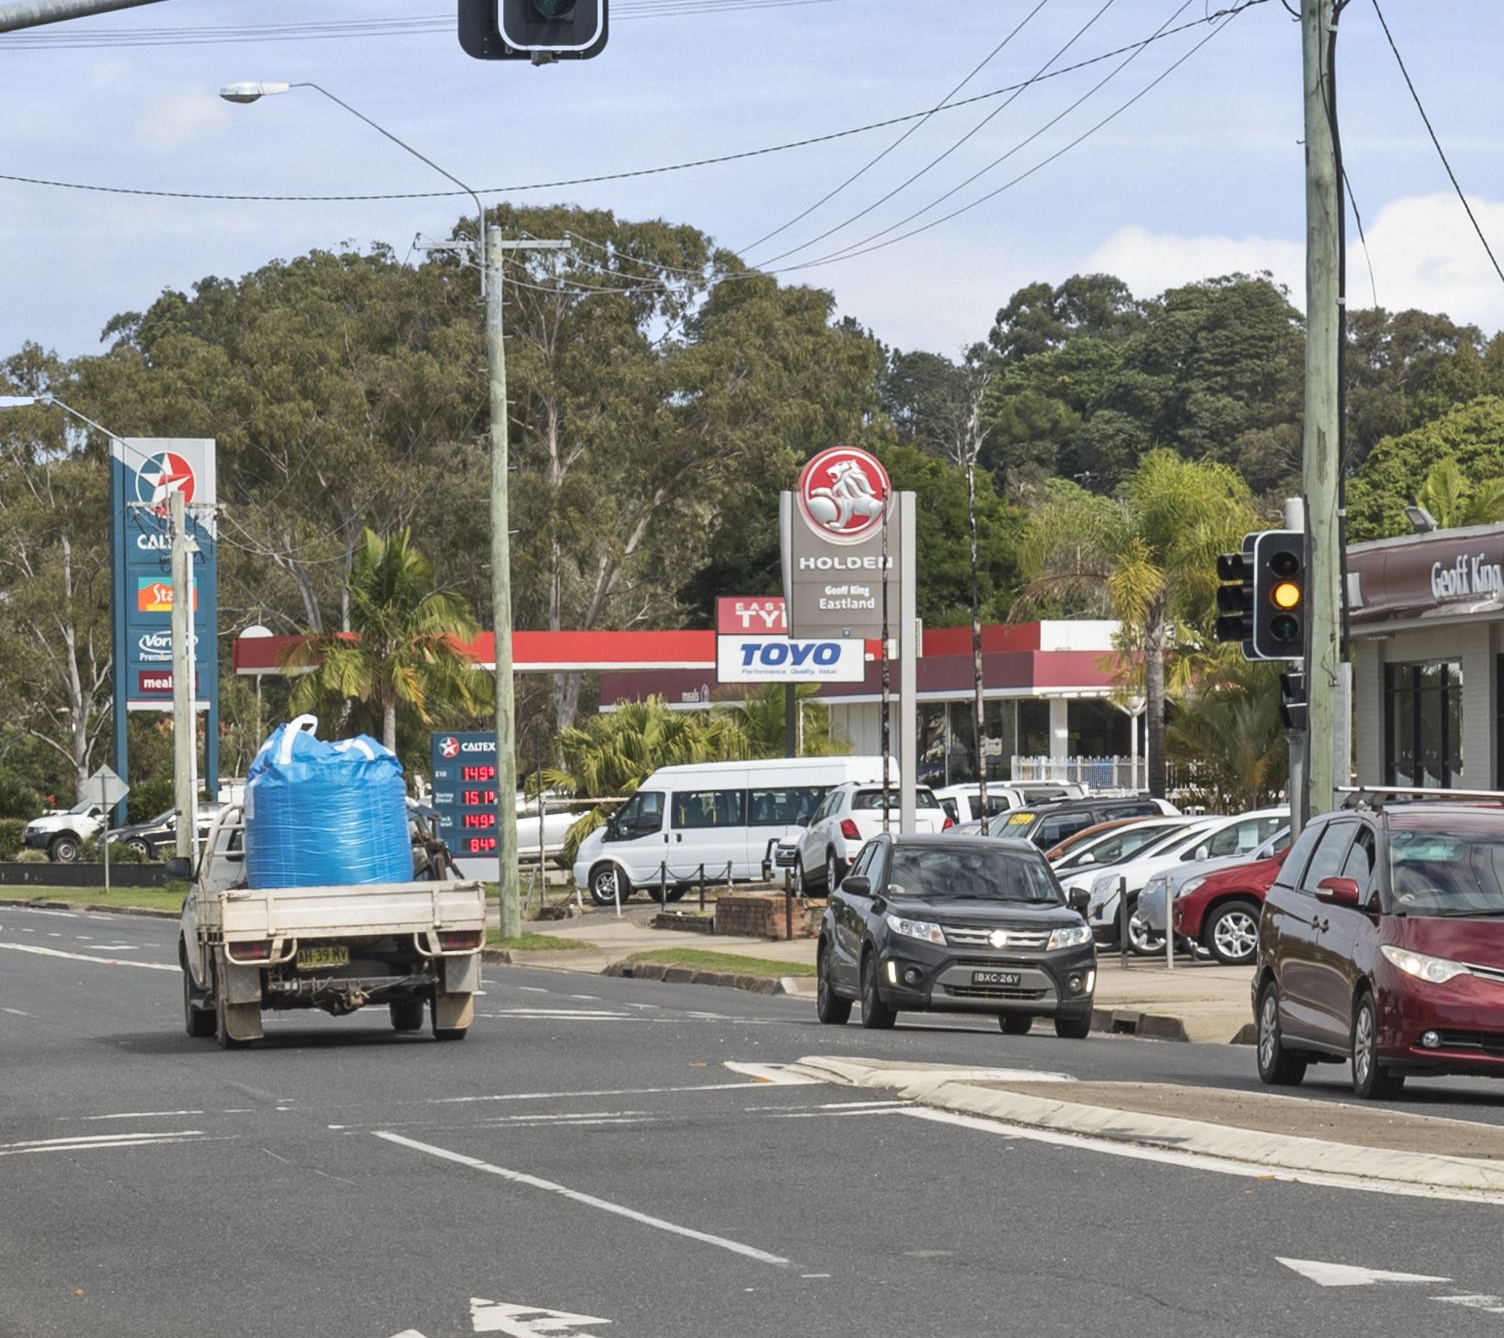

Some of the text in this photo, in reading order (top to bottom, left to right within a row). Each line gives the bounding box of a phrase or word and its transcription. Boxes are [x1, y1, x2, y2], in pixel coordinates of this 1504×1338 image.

[799, 557, 894, 570] HOLDEN
[1431, 554, 1470, 598] Geoff
[825, 585, 870, 597] Geoff King
[819, 598, 875, 609] Eastland
[740, 643, 841, 666] TOYO
[461, 742, 496, 752] CALTEX
